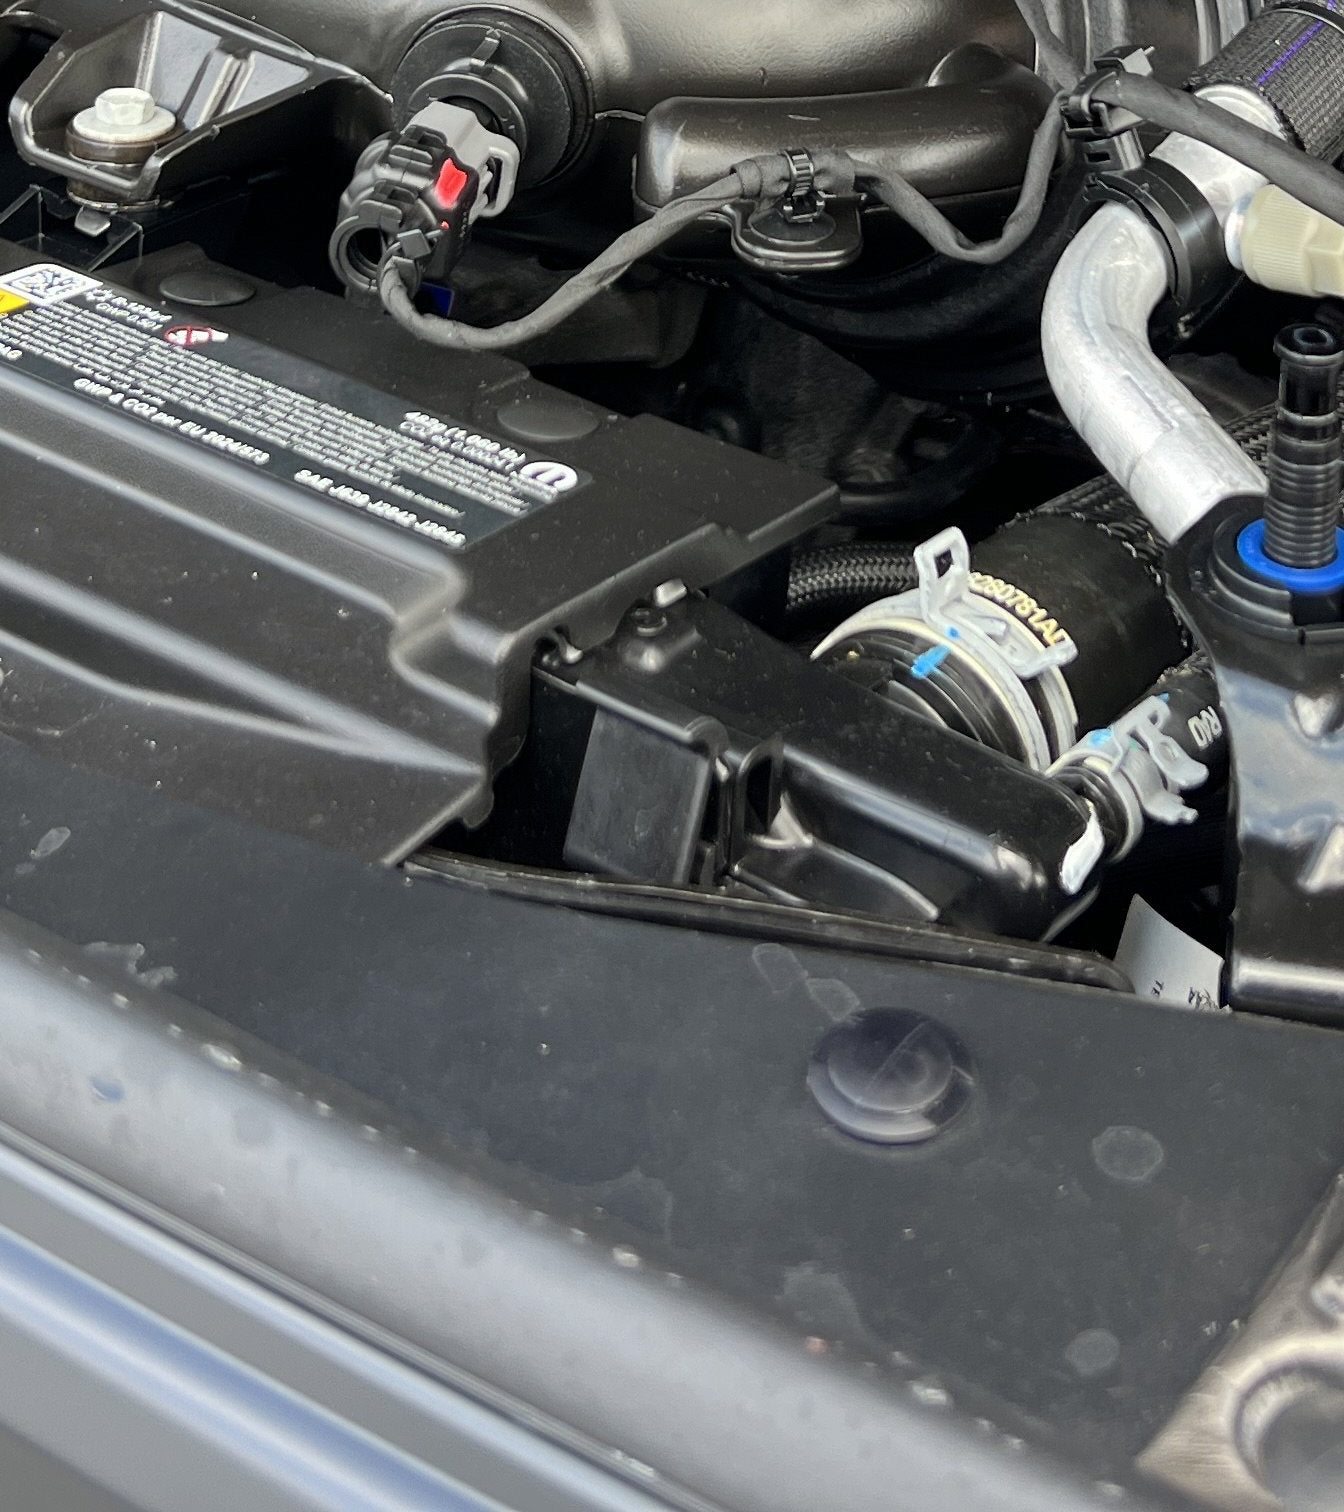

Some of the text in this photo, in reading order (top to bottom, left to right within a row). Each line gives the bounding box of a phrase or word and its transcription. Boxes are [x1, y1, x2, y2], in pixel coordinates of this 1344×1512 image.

[176, 420, 207, 436] EU
[293, 468, 334, 491] SAE
[1187, 705, 1223, 749] RAD
